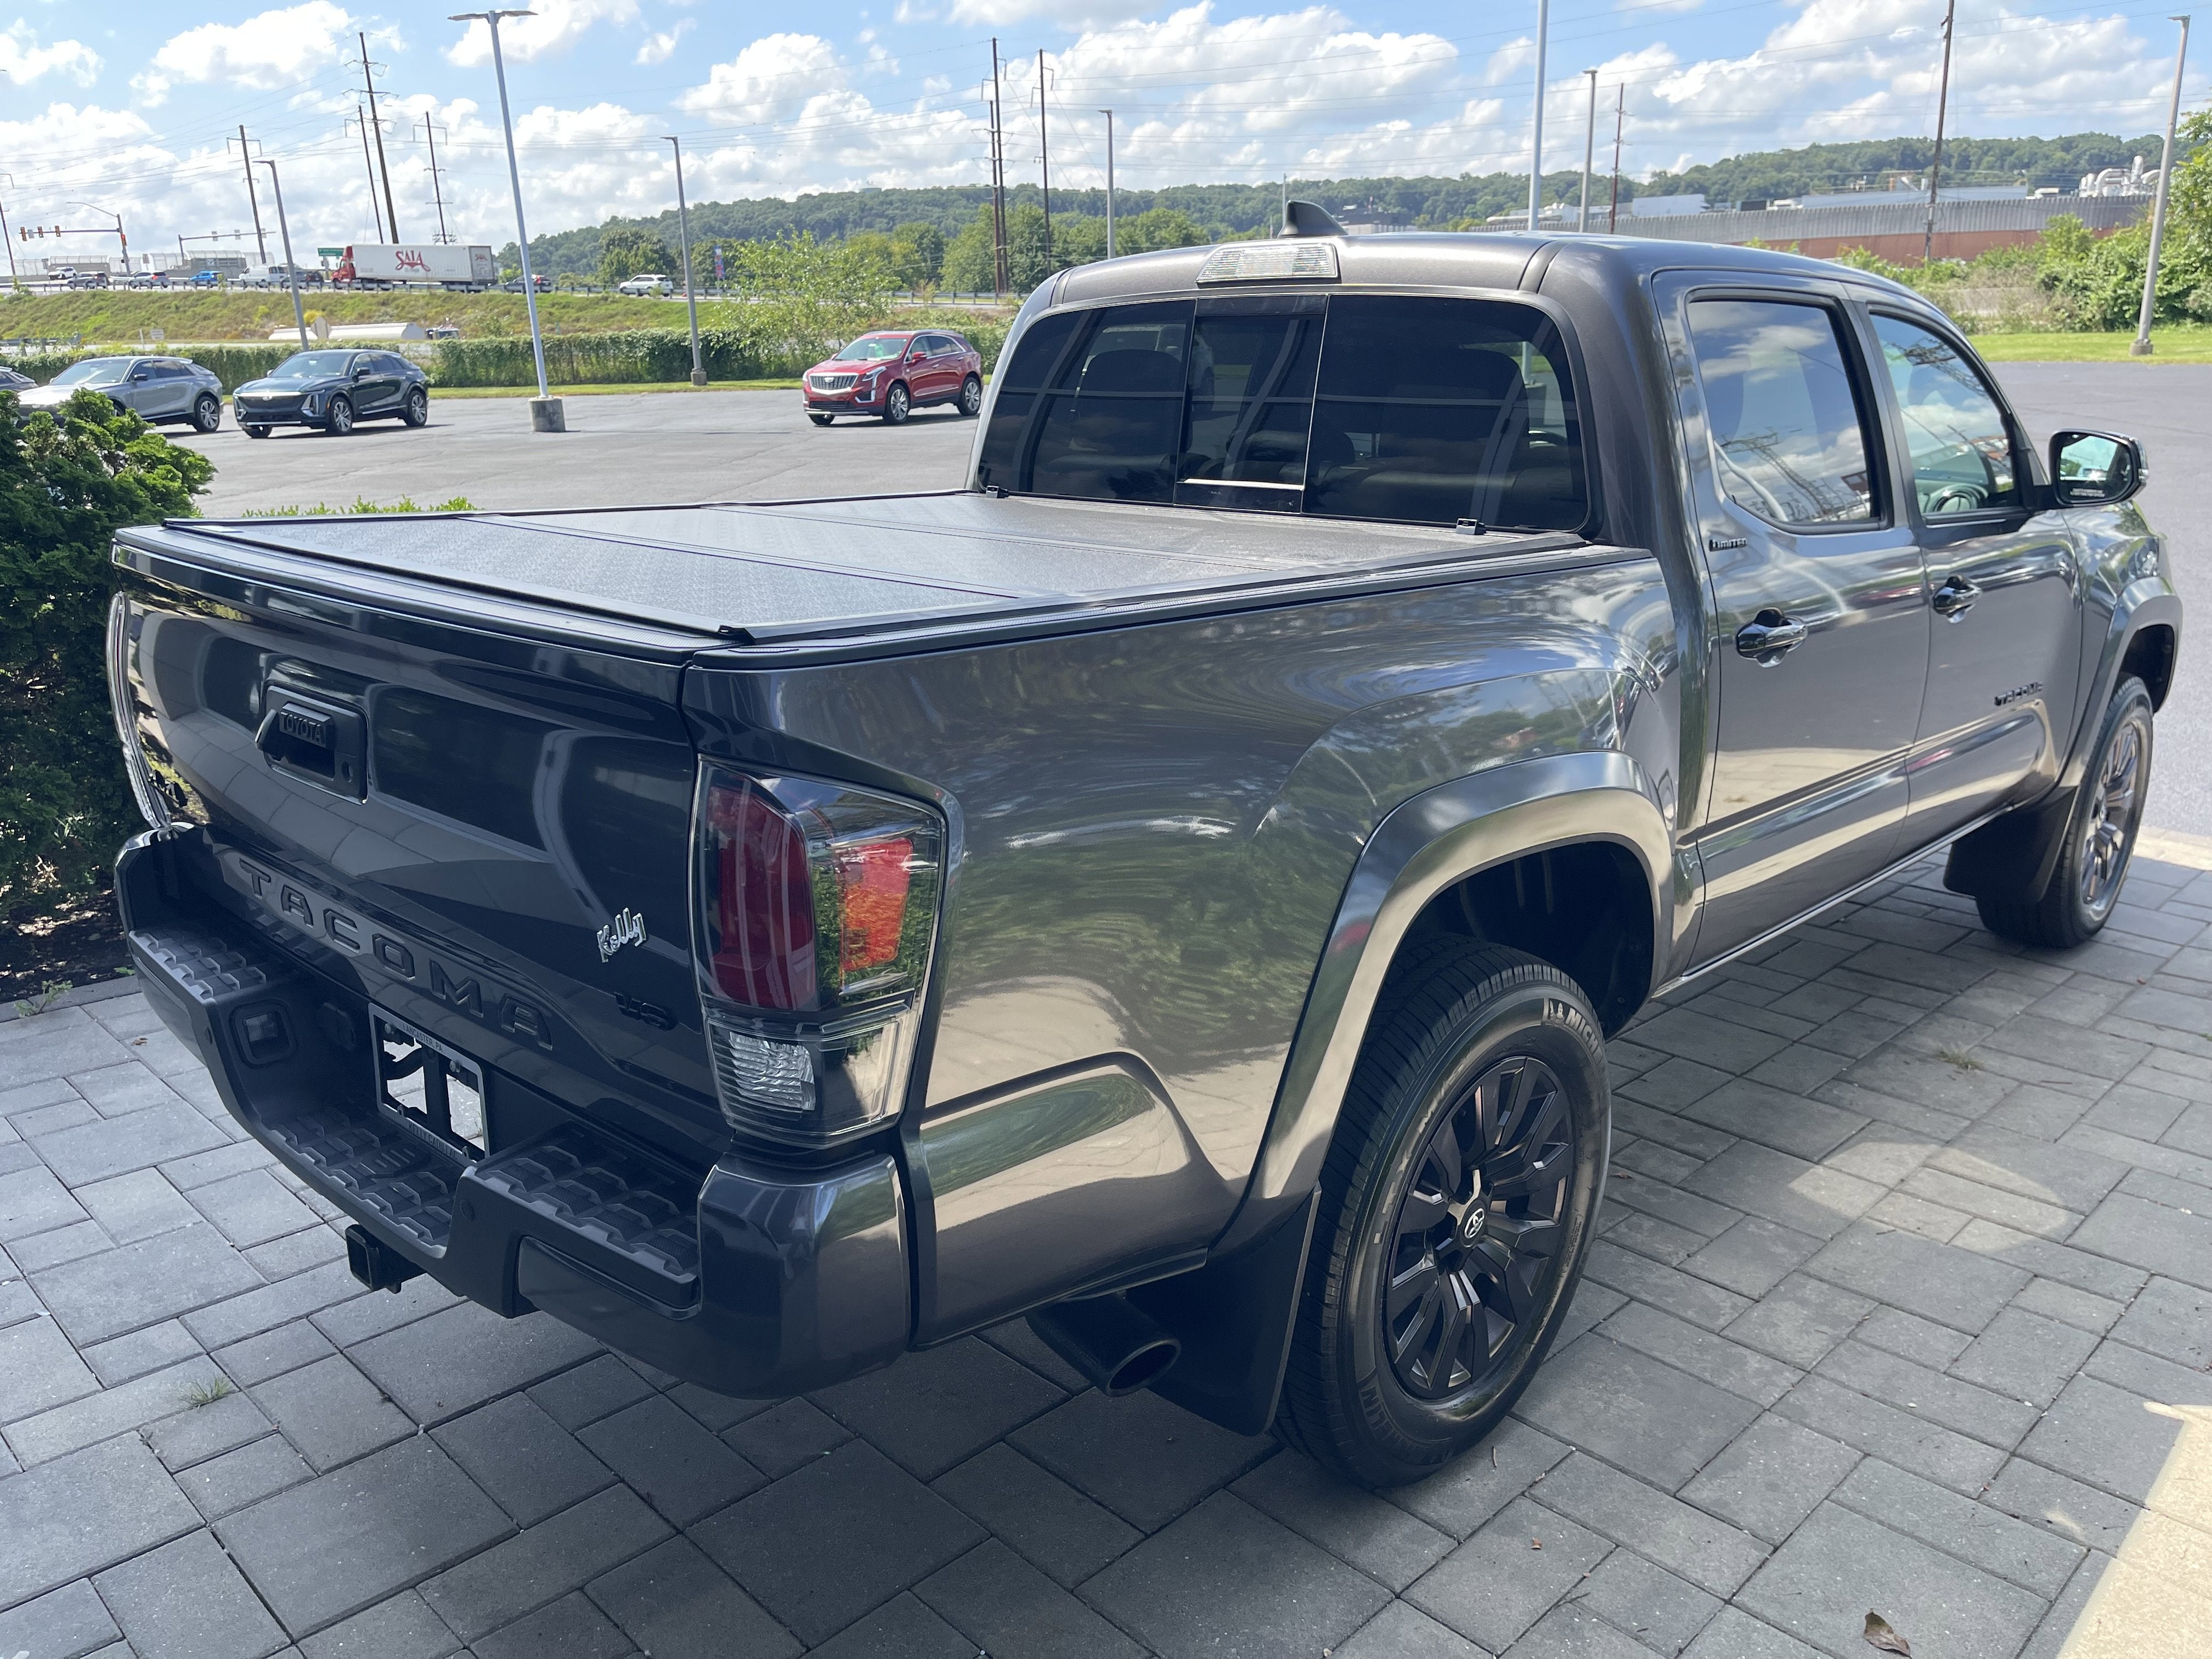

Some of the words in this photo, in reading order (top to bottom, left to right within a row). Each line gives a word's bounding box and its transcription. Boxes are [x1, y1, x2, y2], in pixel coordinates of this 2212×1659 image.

[395, 250, 431, 272] SAIA
[1709, 538, 1747, 551] LIMITED
[280, 712, 326, 746] TOYOTA
[239, 858, 553, 1051] TACOMA
[597, 907, 647, 963] Kelly
[613, 991, 678, 1032] V6
[403, 1023, 435, 1048] LANCASTER,
[435, 1043, 443, 1053] PA
[408, 1121, 427, 1144] KELLY
[428, 1133, 458, 1161] CADILLAC
[1373, 1150, 1413, 1244] LTX
